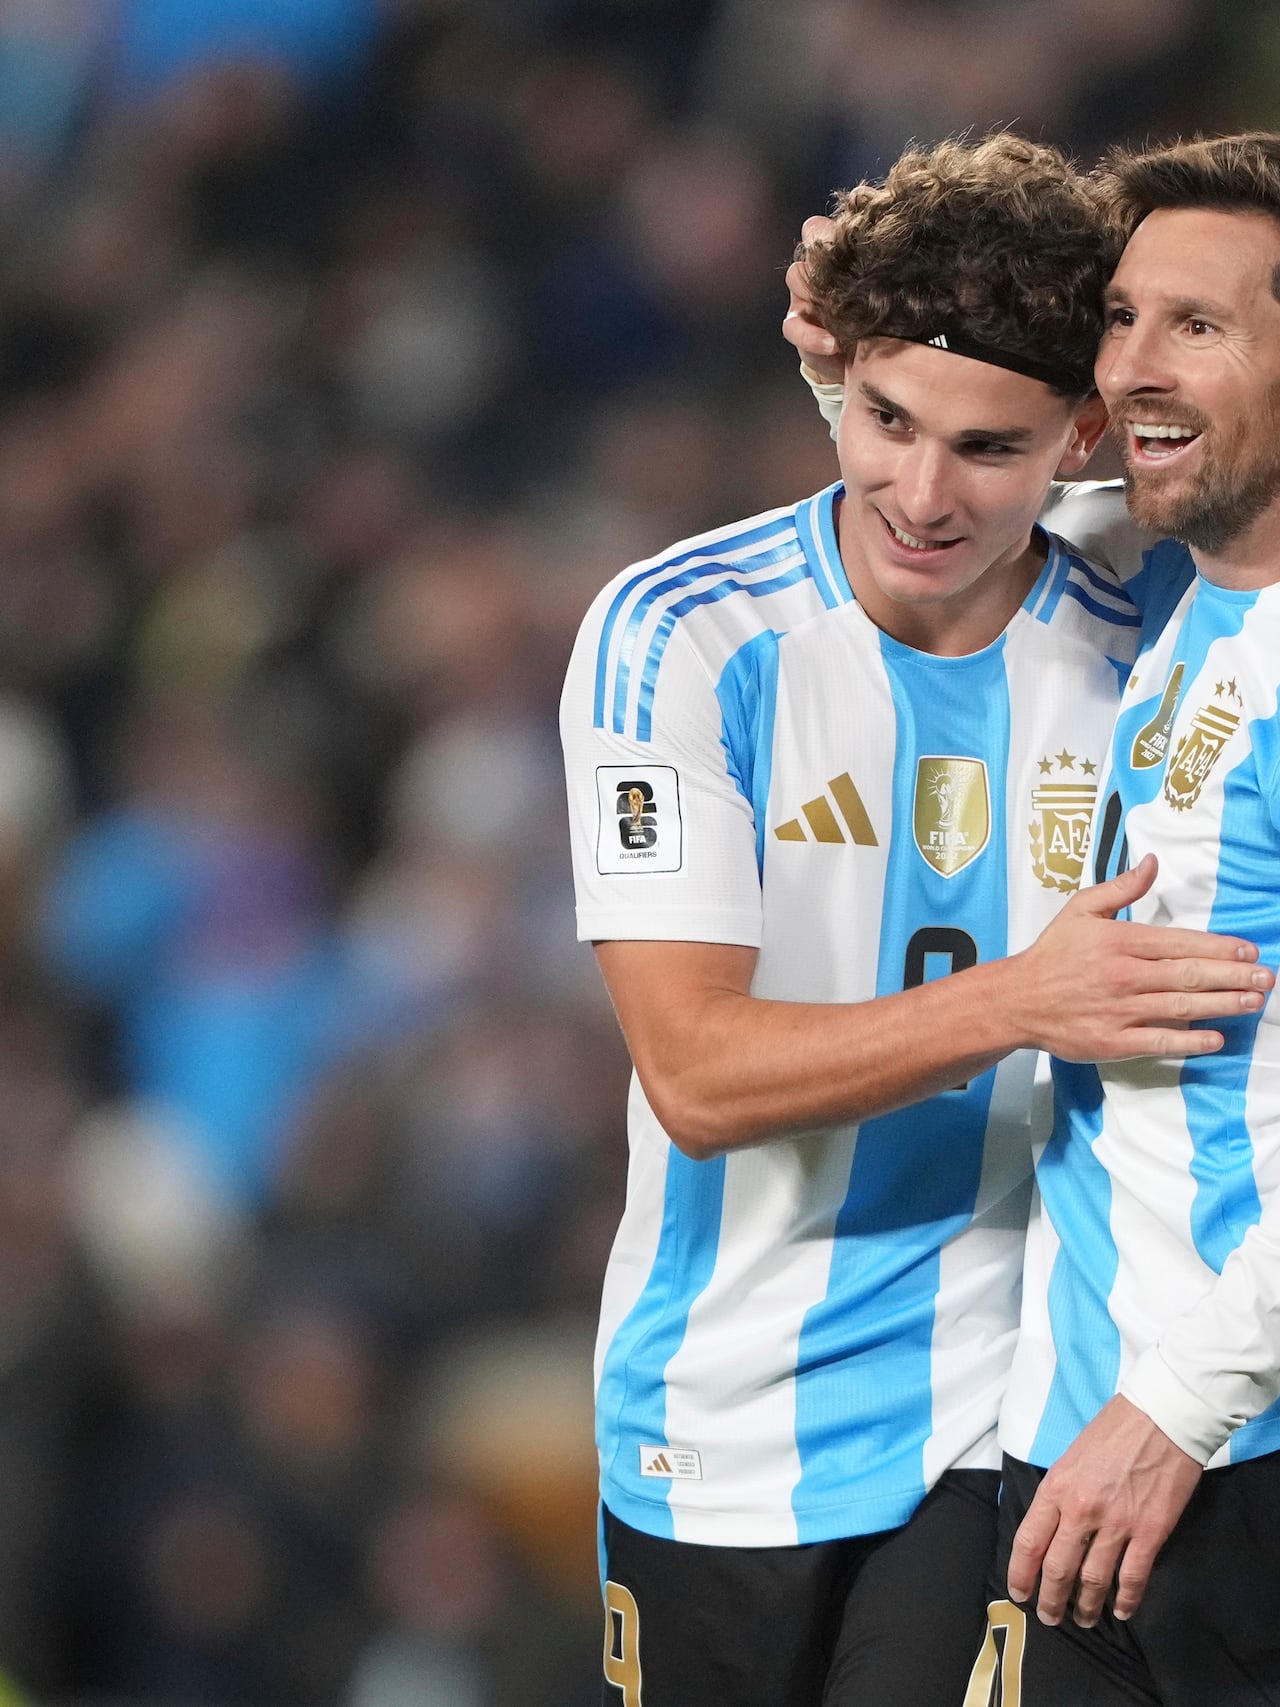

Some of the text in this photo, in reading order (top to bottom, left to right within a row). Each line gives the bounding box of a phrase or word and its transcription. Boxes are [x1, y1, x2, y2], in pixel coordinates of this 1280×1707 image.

[1149, 732, 1169, 751] FIFA
[1178, 733, 1219, 784] AFA
[628, 835, 647, 845] FIFA
[928, 831, 967, 846] FIFA
[1048, 811, 1091, 863] AFA
[619, 851, 658, 860] QUALIFIERS
[603, 1580, 642, 1707] 9
